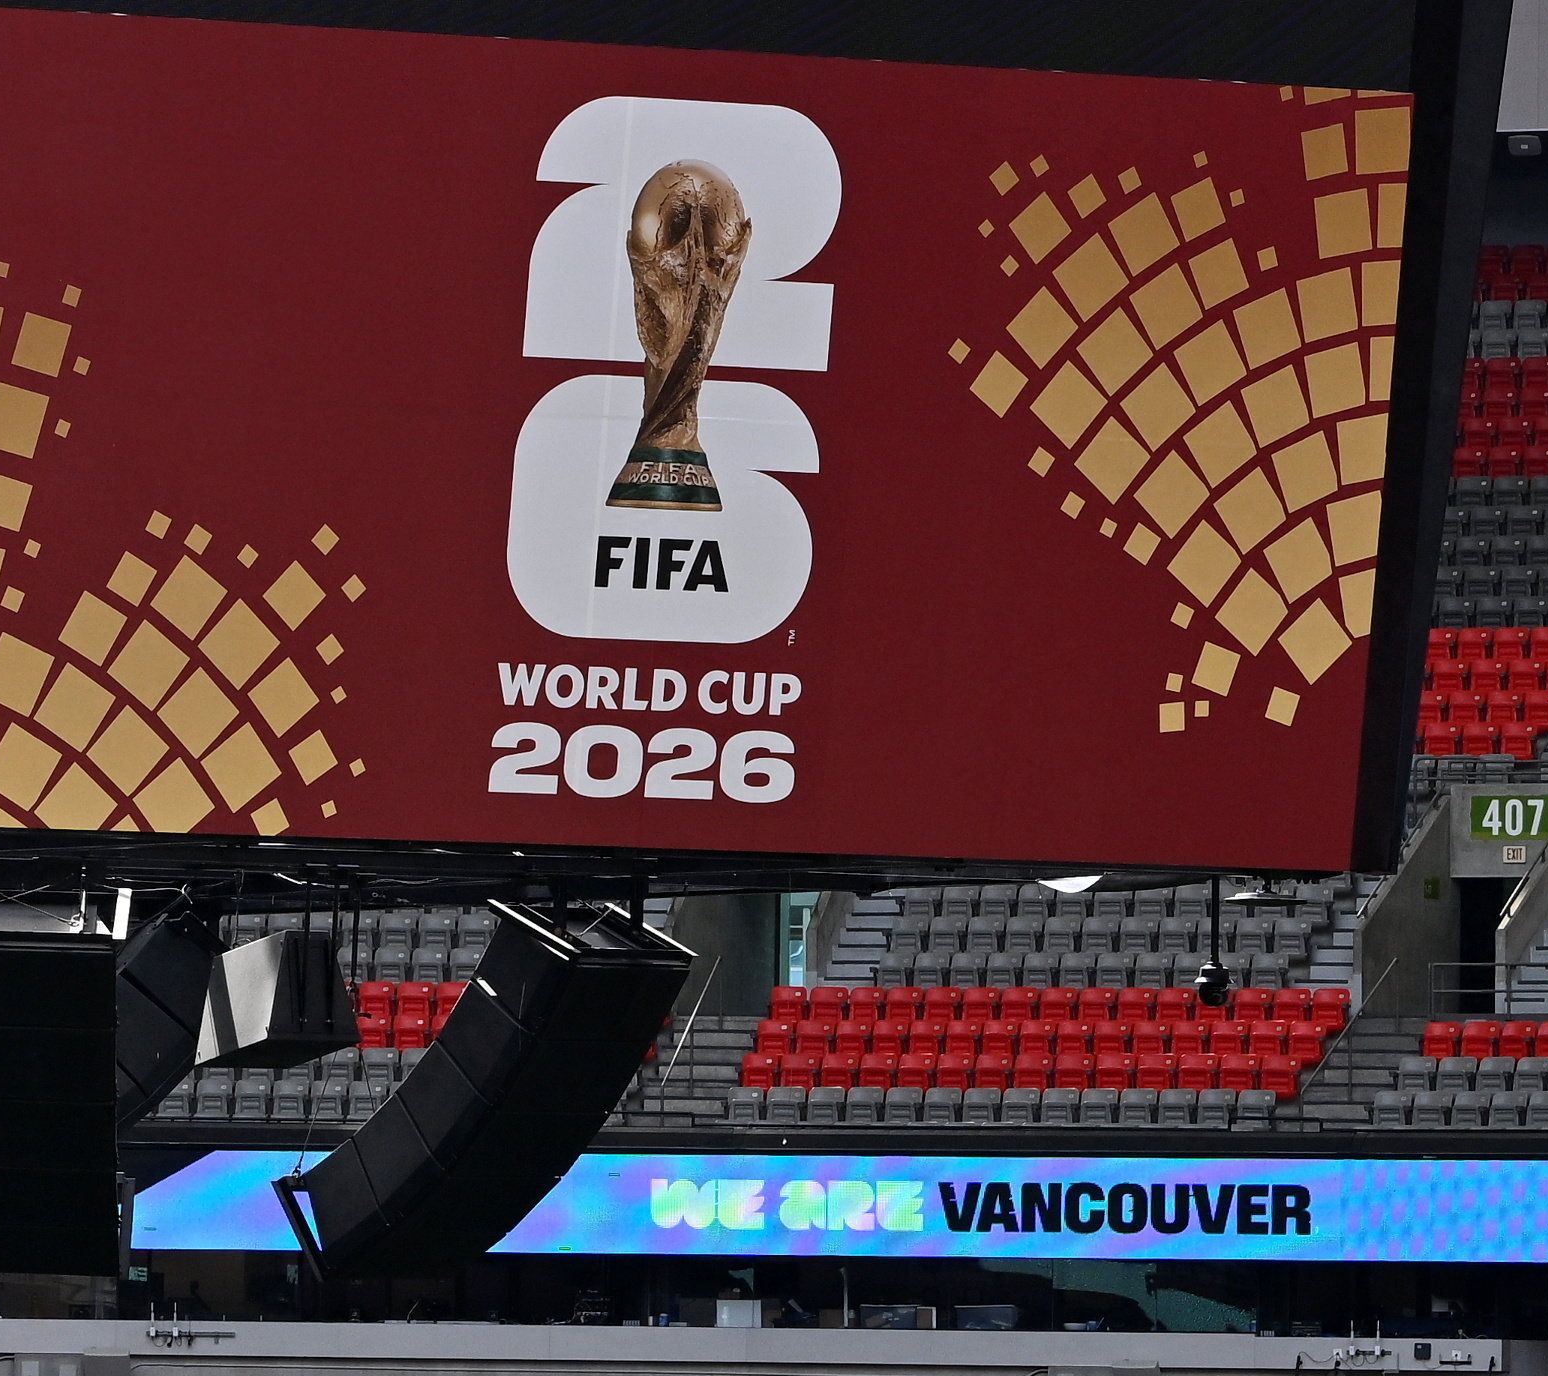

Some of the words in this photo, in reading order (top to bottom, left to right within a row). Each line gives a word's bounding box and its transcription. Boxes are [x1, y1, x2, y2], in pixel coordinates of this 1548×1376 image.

[628, 473, 679, 485] WORLD
[683, 474, 709, 486] CUP
[640, 461, 698, 474] FIFA
[595, 536, 728, 592] FIFA
[498, 663, 686, 711] WORLD
[698, 671, 801, 715] CUP
[489, 722, 794, 803] 2026
[1483, 800, 1543, 835] 407
[1506, 847, 1523, 861] EXIT
[651, 1178, 765, 1230] WE
[939, 1182, 1310, 1235] VANCOUVER
